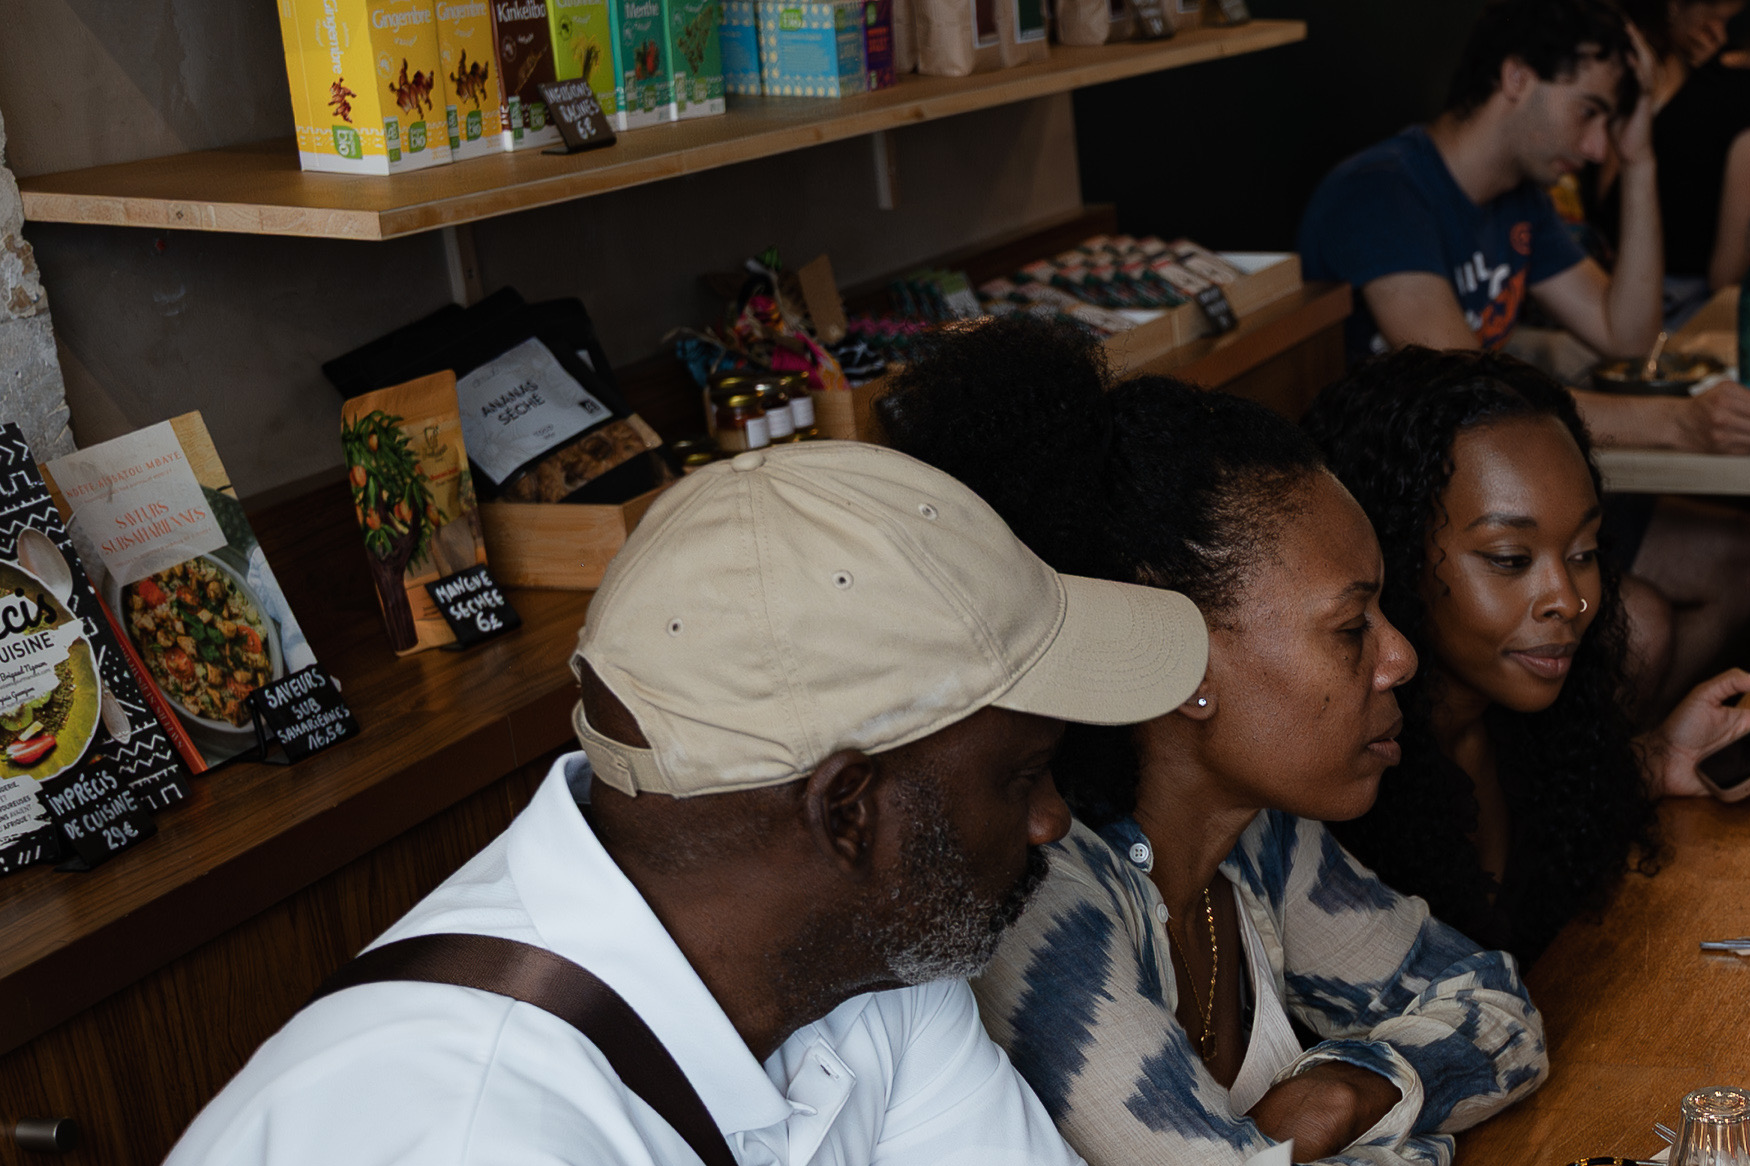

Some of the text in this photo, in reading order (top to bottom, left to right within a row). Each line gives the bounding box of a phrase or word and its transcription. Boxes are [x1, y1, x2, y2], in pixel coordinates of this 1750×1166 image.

[372, 6, 431, 33] Gingembre
[434, 569, 493, 604] MANGUE
[264, 666, 326, 709] SAVEURS
[291, 695, 321, 721] SUB
[63, 818, 85, 840] DE
[102, 818, 138, 851] 29€
